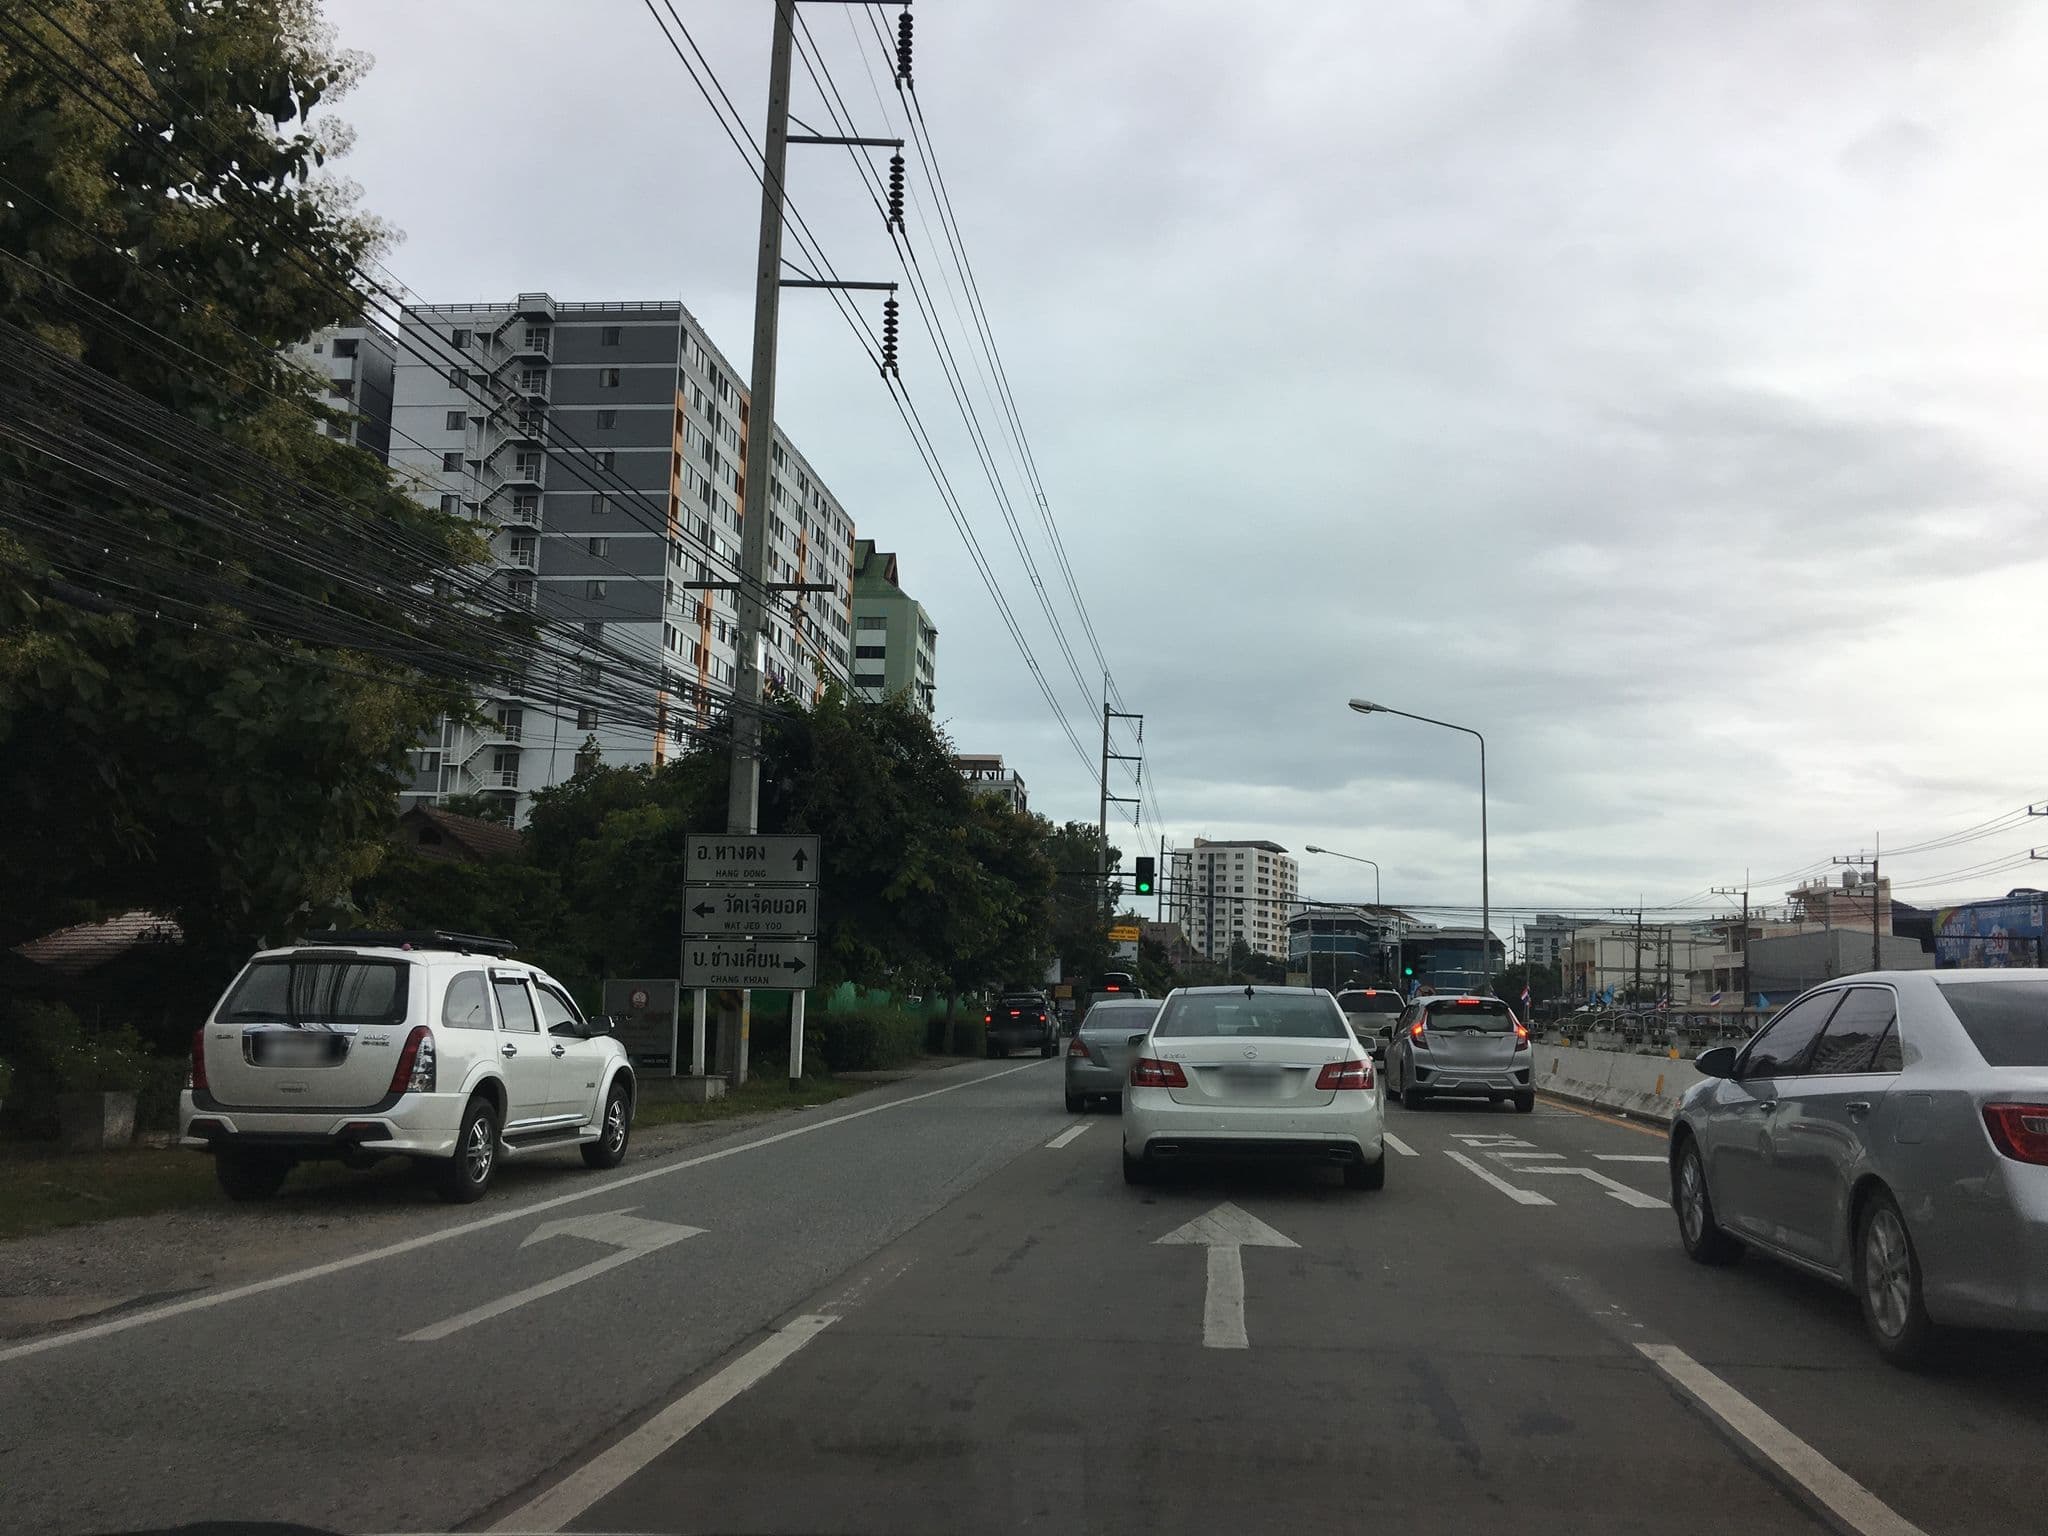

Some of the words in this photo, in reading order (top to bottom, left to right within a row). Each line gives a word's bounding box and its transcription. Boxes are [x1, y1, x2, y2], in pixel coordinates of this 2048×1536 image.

[715, 870, 739, 879] HANG
[743, 870, 766, 880] DONG
[724, 922, 741, 931] WAT
[710, 975, 739, 985] CHANG
